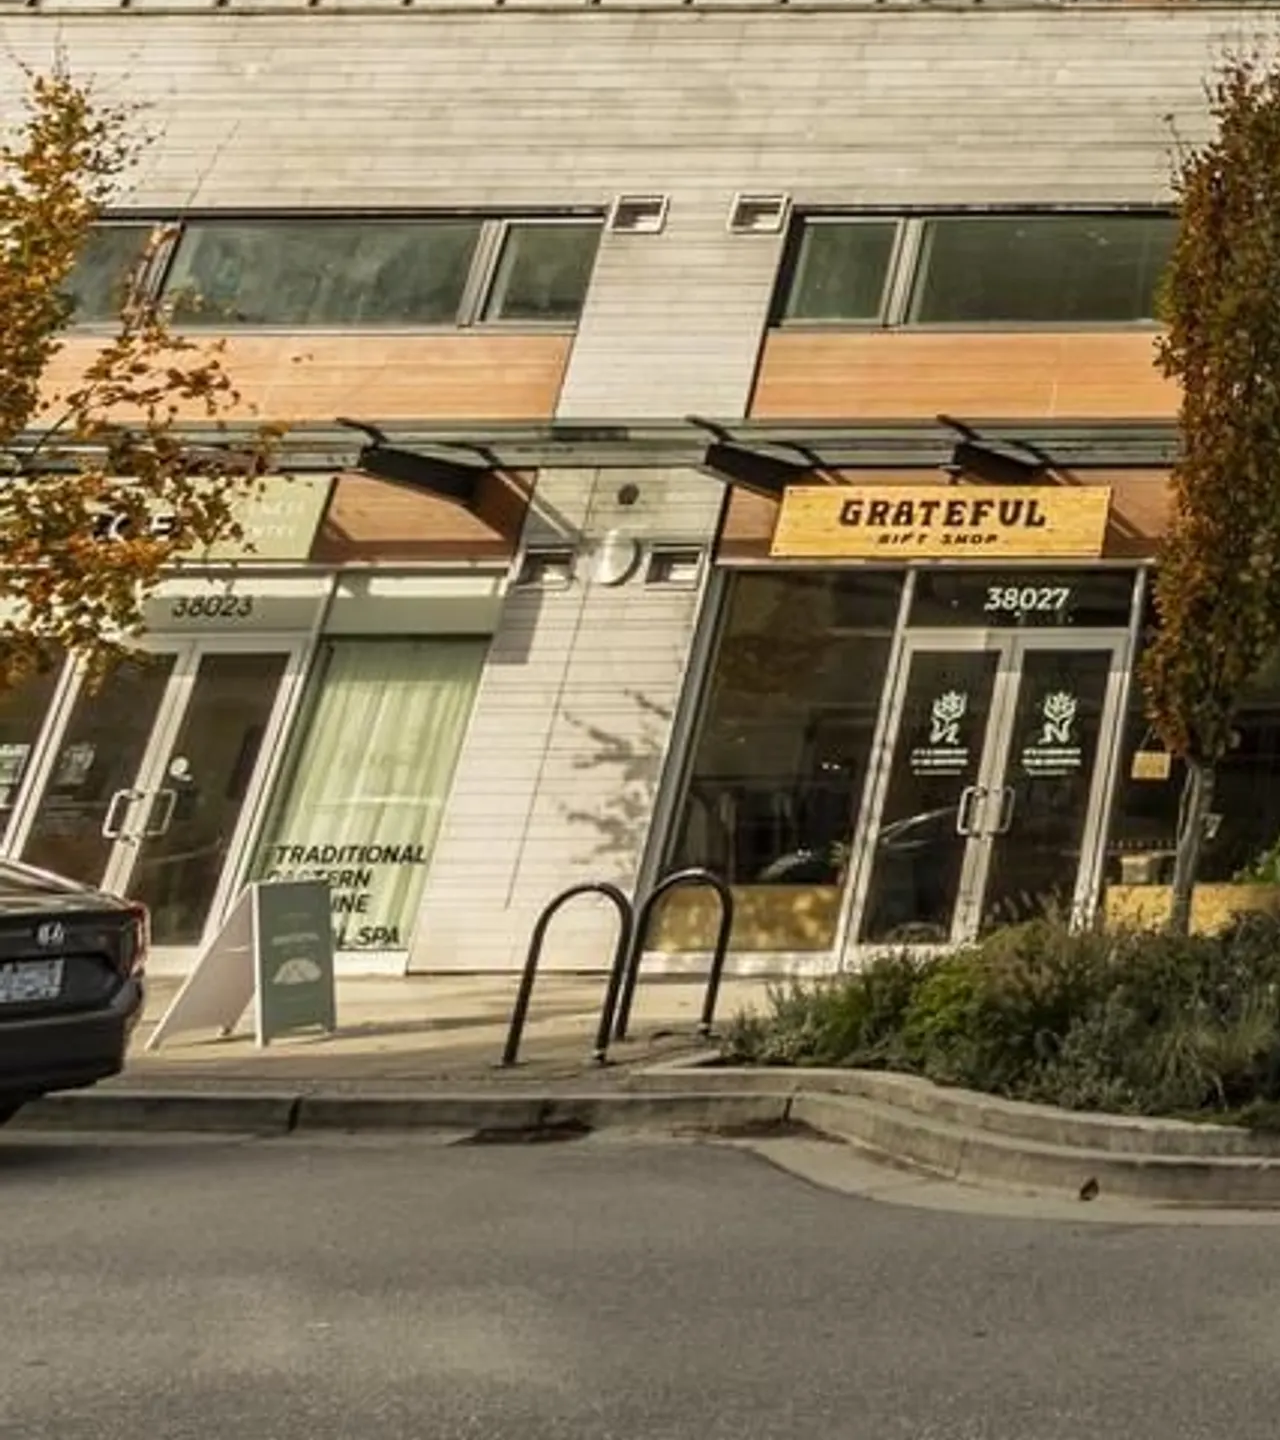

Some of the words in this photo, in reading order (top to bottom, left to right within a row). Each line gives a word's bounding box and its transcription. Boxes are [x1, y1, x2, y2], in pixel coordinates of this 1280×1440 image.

[839, 500, 1046, 527] GRATEFUL
[878, 533, 928, 545] GIFT
[941, 533, 999, 545] SHOP
[172, 596, 253, 617] 38023
[984, 588, 1070, 610] 38027
[275, 845, 427, 864] TRADITIONAL
[357, 927, 400, 946] SPA
